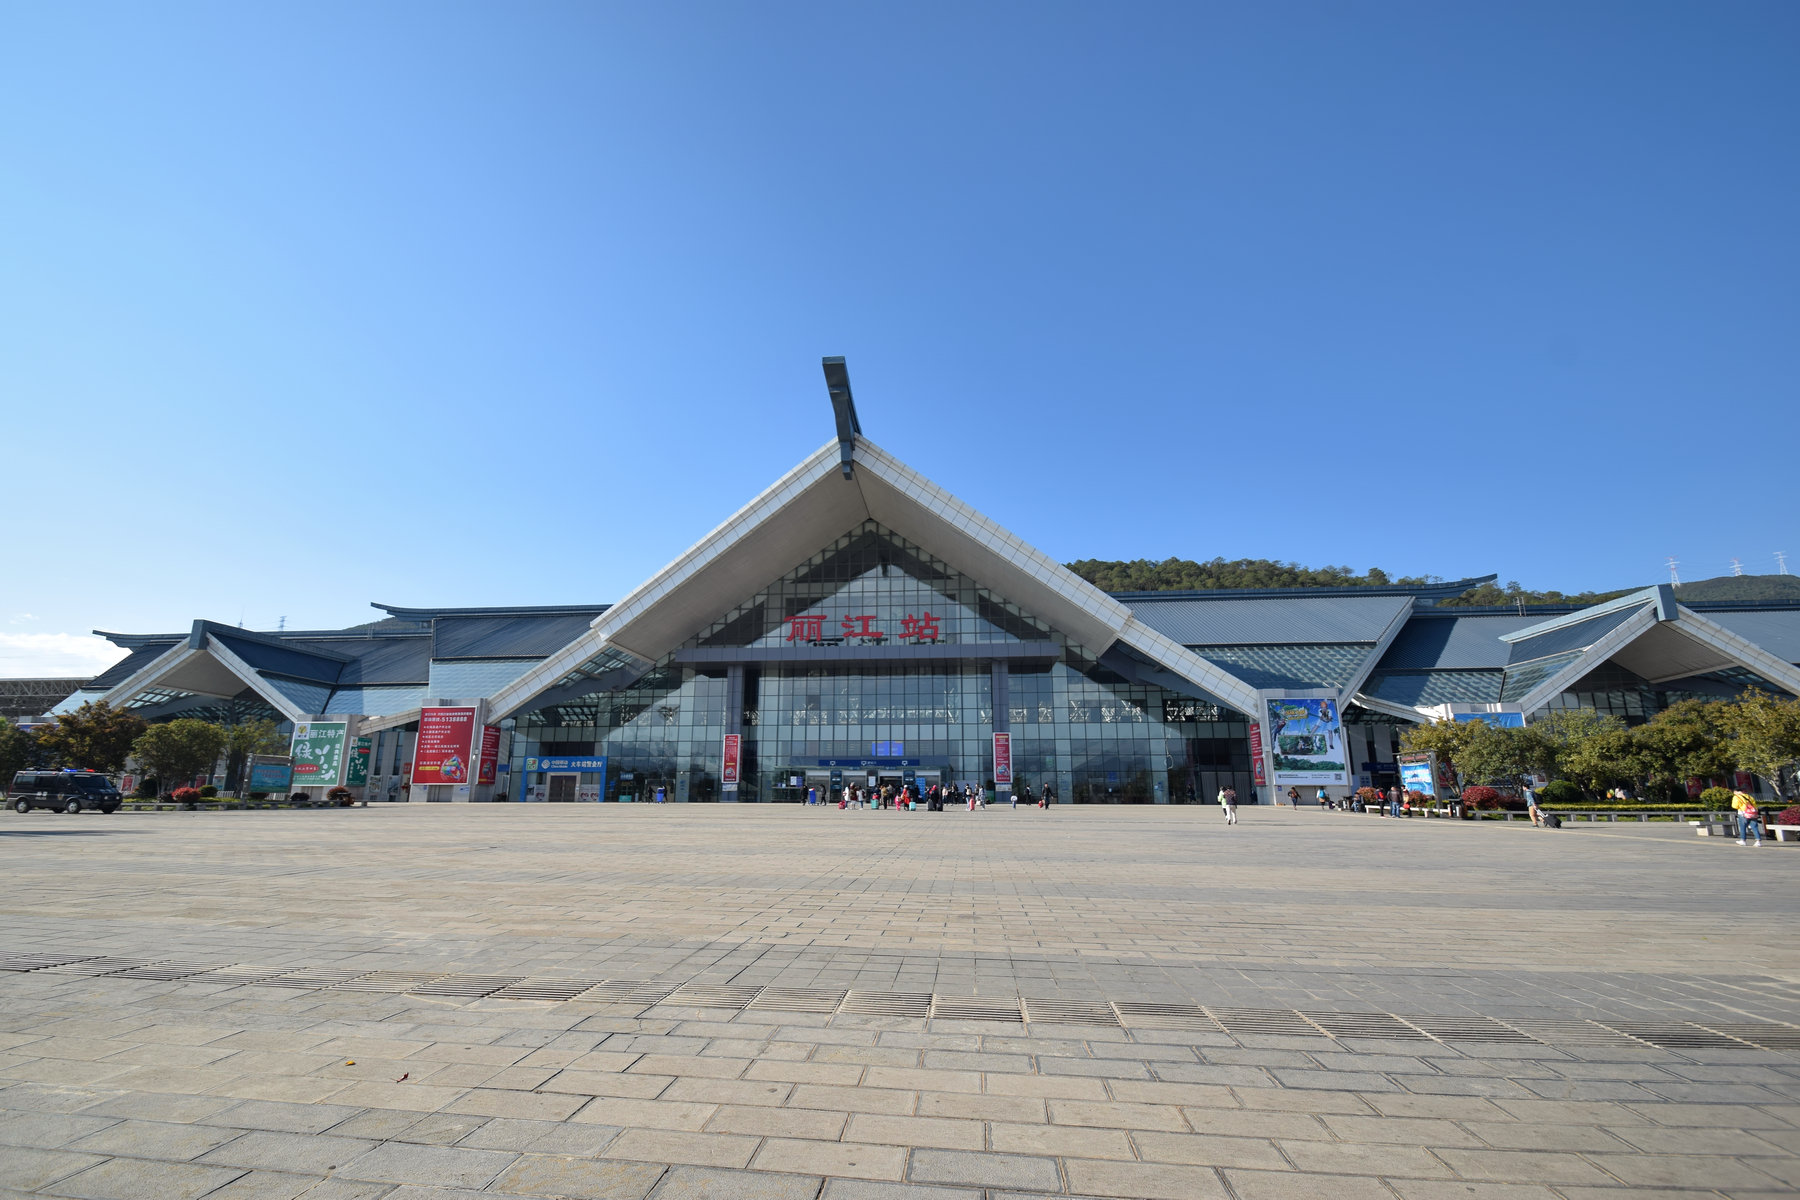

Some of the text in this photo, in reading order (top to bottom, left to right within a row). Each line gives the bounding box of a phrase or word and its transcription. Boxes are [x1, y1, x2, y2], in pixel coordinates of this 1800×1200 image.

[784, 611, 941, 642] 丽江站
[310, 729, 345, 738] 丽江特产
